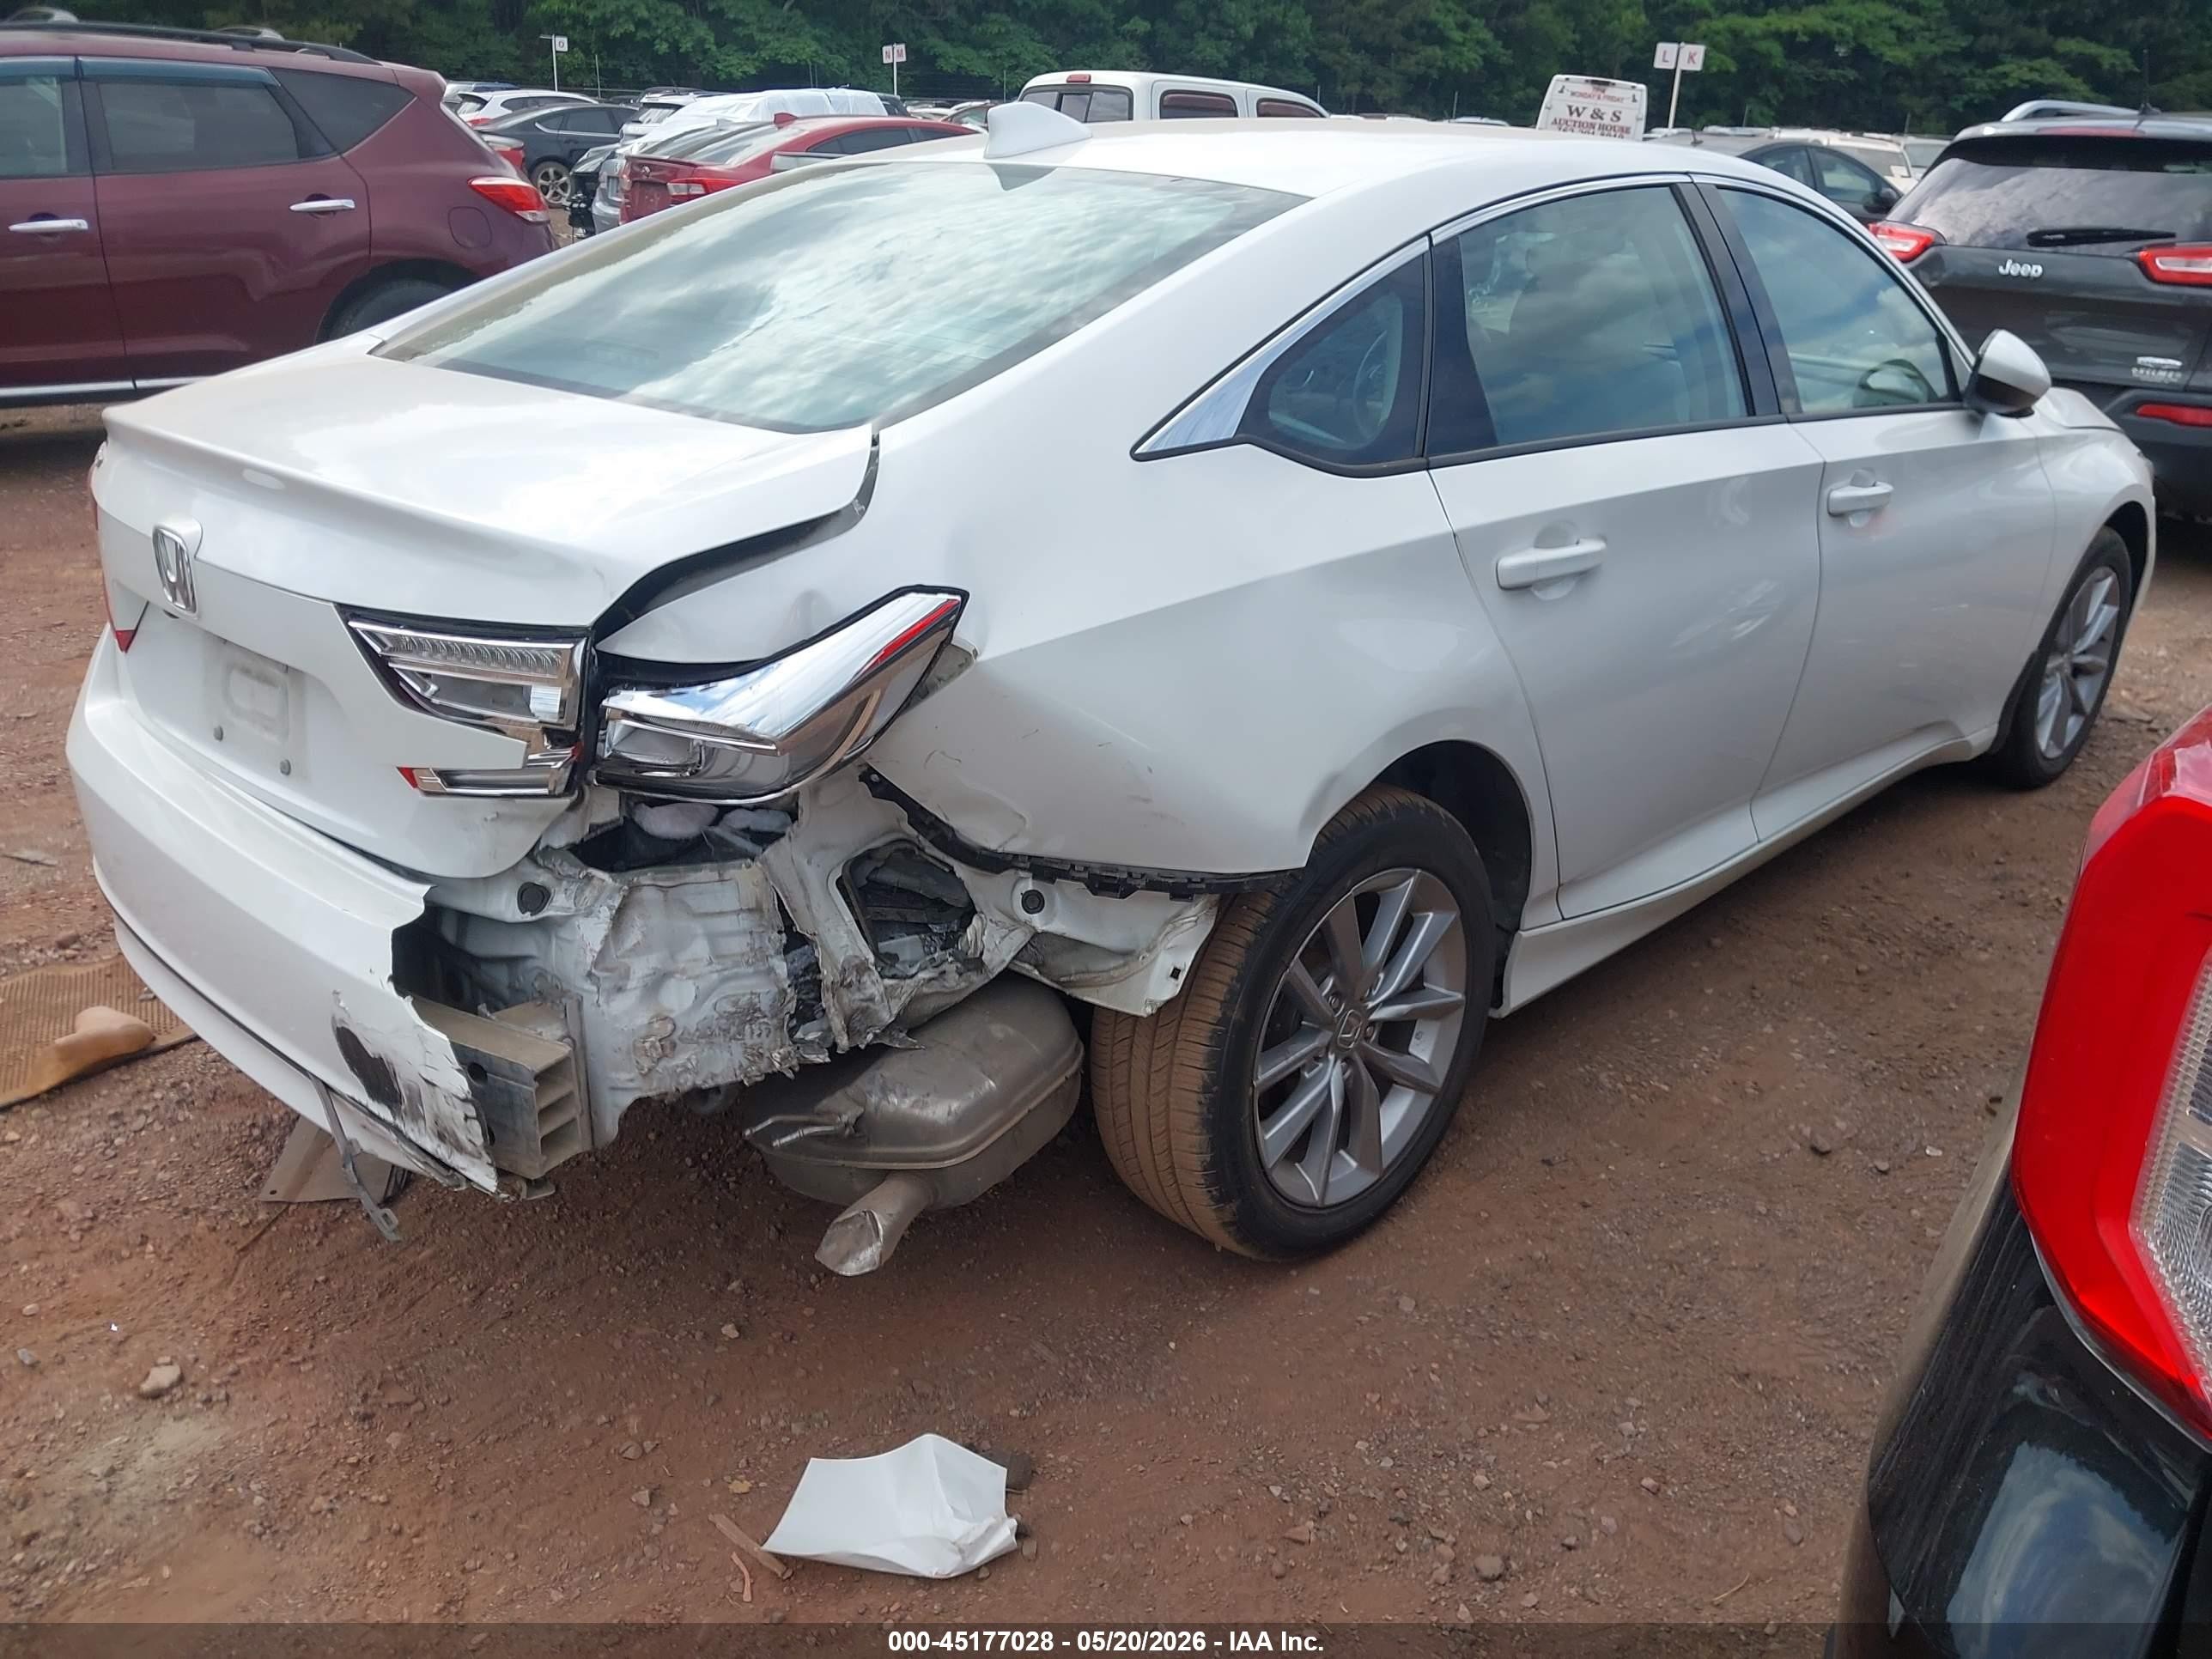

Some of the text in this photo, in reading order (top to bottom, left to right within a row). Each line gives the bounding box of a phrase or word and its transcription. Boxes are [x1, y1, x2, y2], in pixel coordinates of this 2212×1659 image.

[884, 50, 891, 61] N
[896, 48, 904, 58] M
[1662, 49, 1670, 63] L
[1686, 51, 1698, 64] K
[1566, 104, 1622, 123] W & S
[1551, 117, 1596, 130] AUCTION
[1597, 122, 1632, 135] HOUSE
[1998, 258, 2044, 278] Jeep
